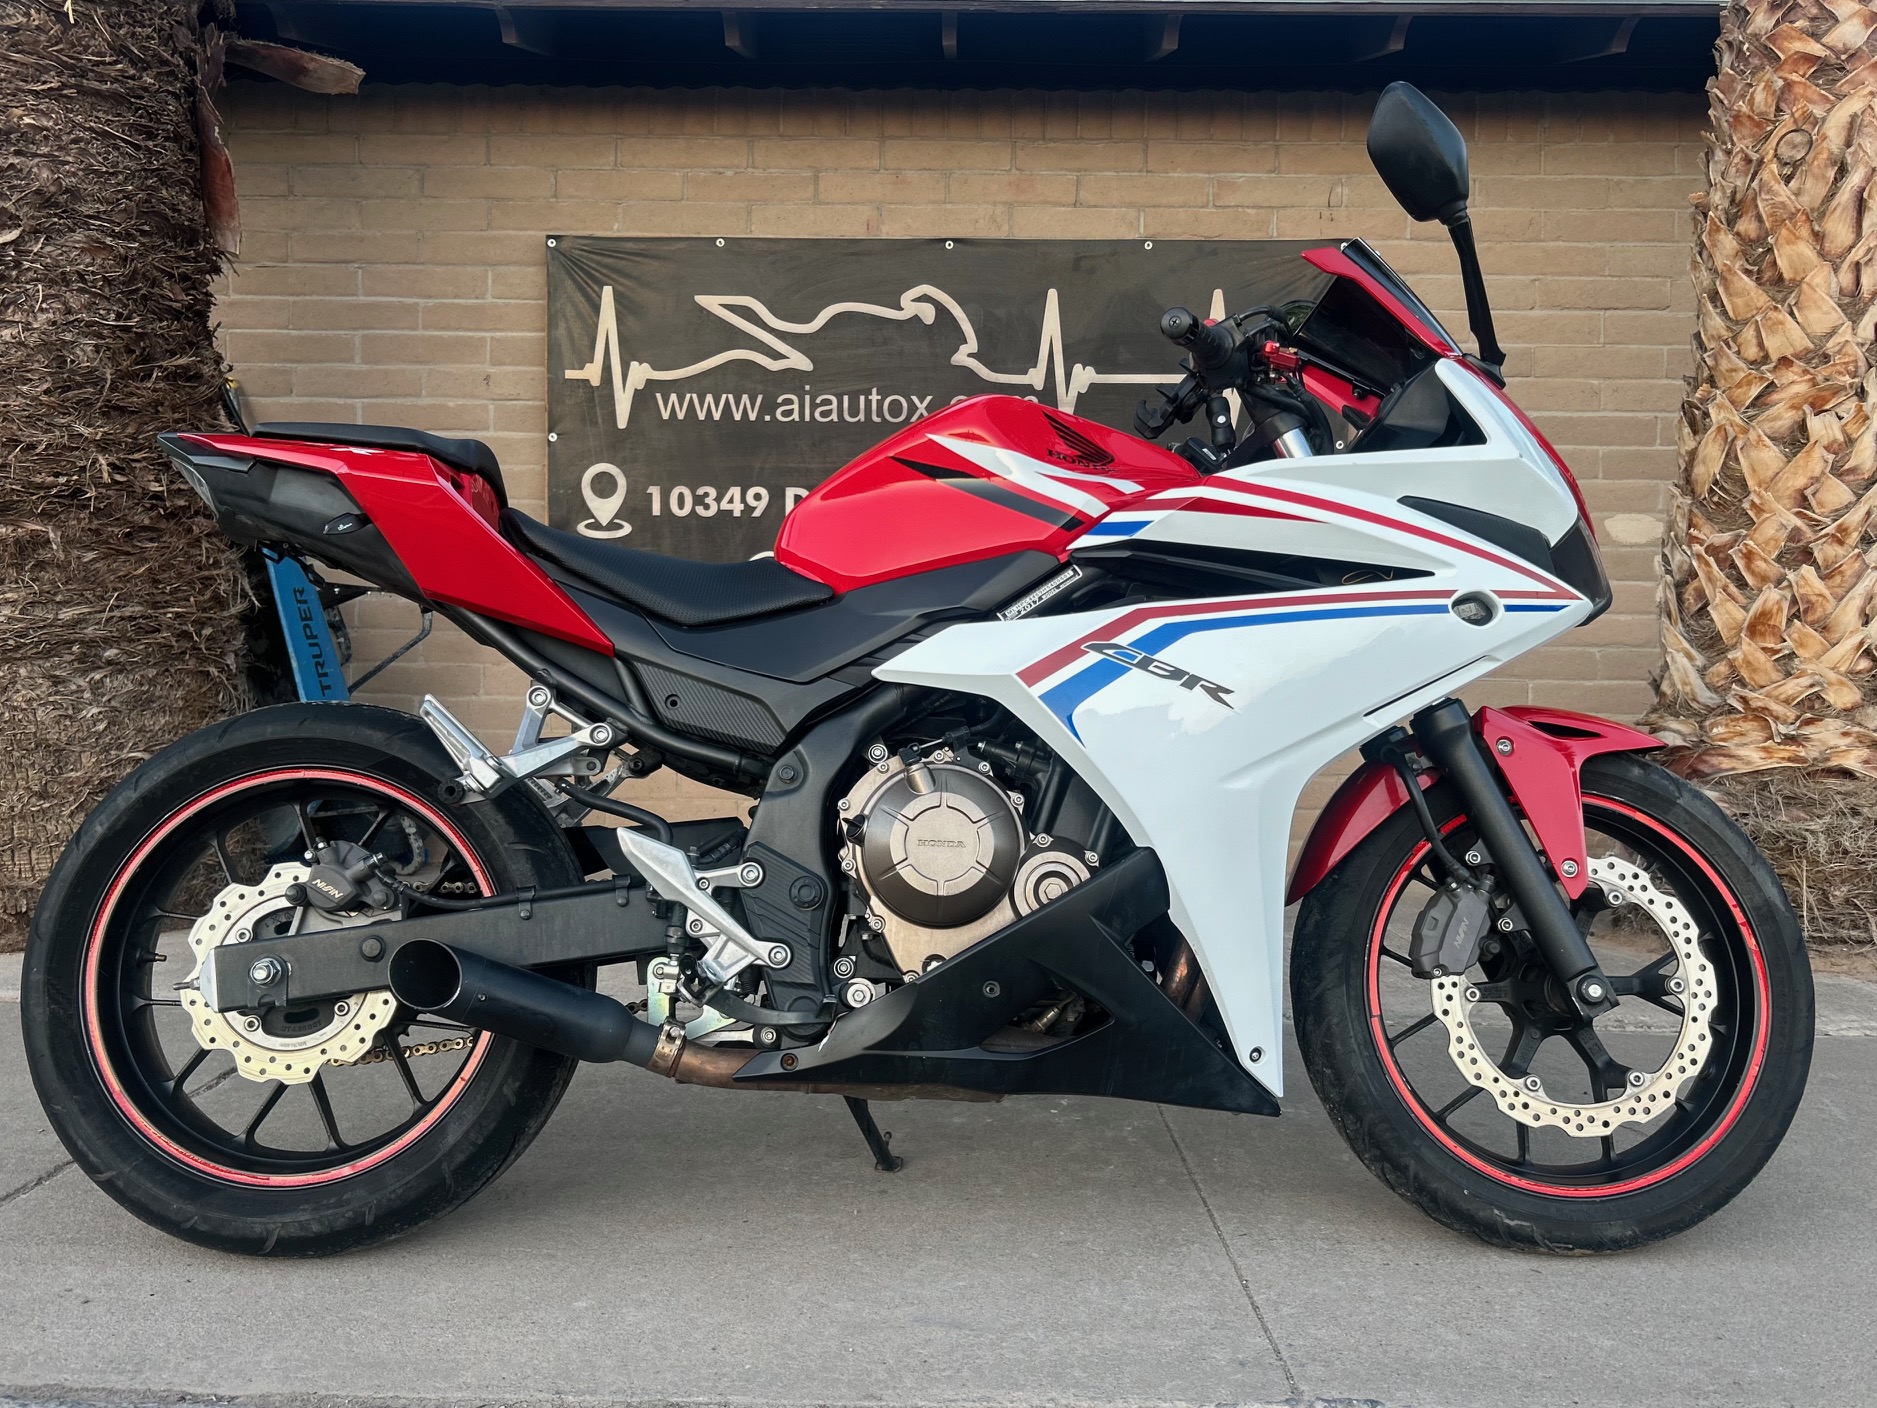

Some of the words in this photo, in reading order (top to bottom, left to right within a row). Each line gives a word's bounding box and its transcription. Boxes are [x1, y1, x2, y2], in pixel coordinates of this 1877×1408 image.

[646, 484, 770, 518] 10349
[292, 585, 332, 697] TRUPER
[1082, 642, 1235, 710] CBR
[916, 838, 967, 849] HONDA
